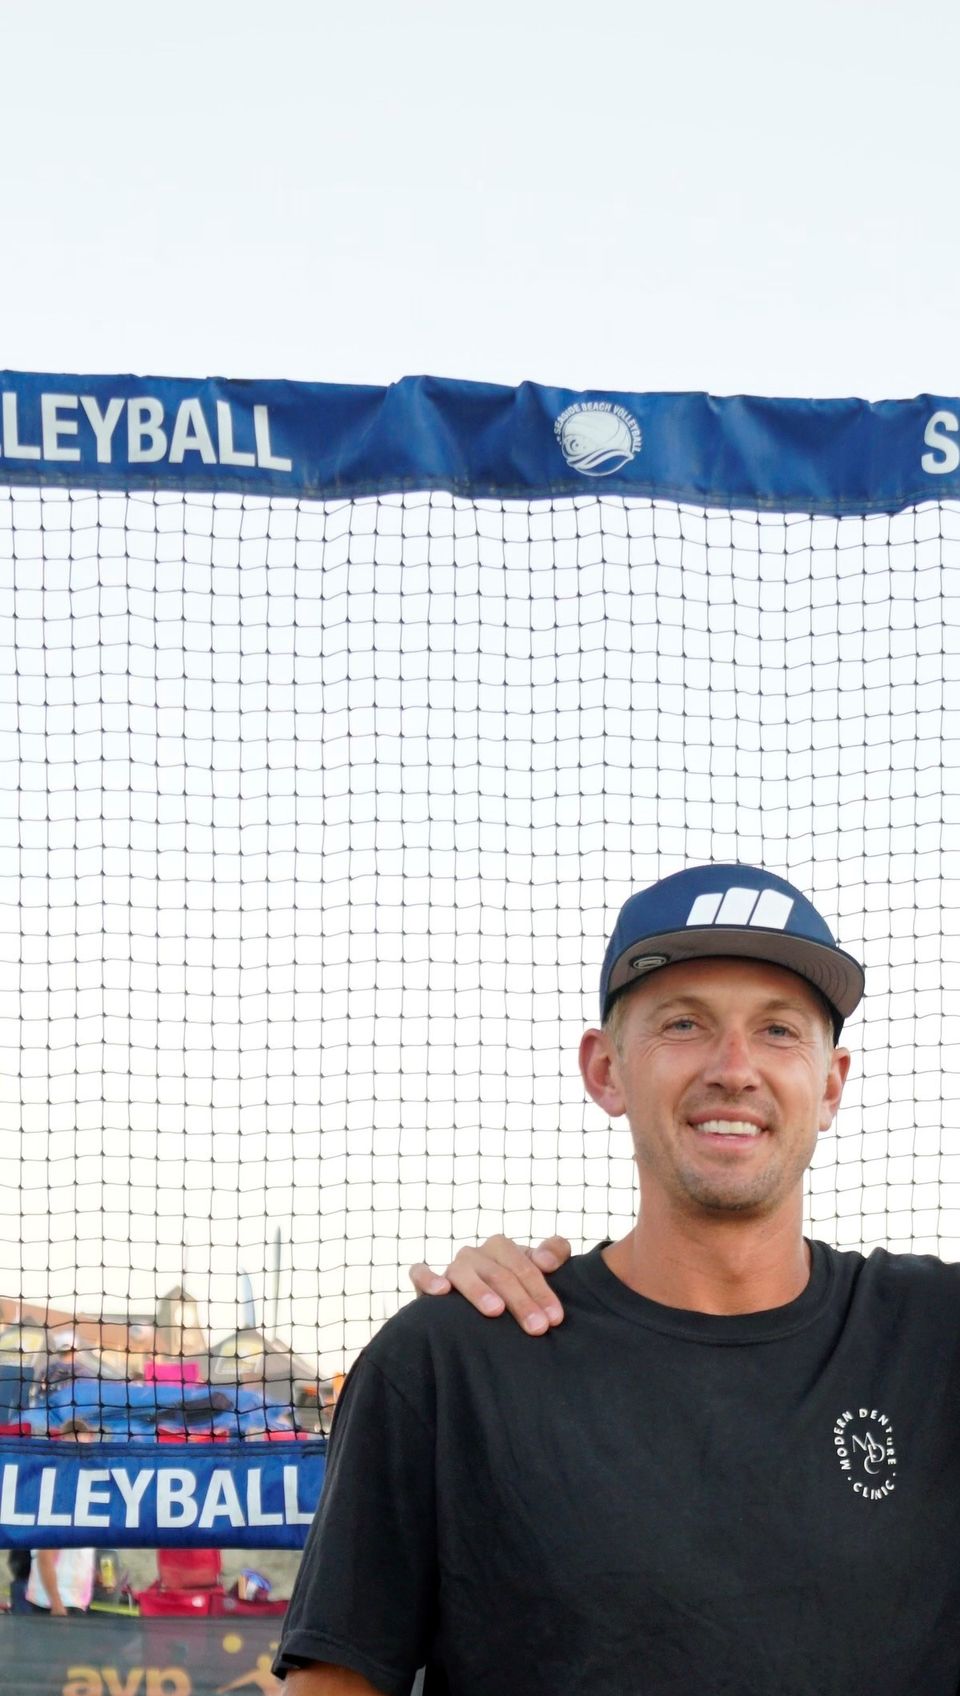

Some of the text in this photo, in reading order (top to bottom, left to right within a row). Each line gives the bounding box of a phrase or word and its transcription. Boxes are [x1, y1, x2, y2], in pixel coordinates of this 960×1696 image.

[834, 1408, 897, 1470] MODERN DENTURE
[0, 1464, 314, 1528] LLEYBALL
[853, 1479, 895, 1500] CLINIC
